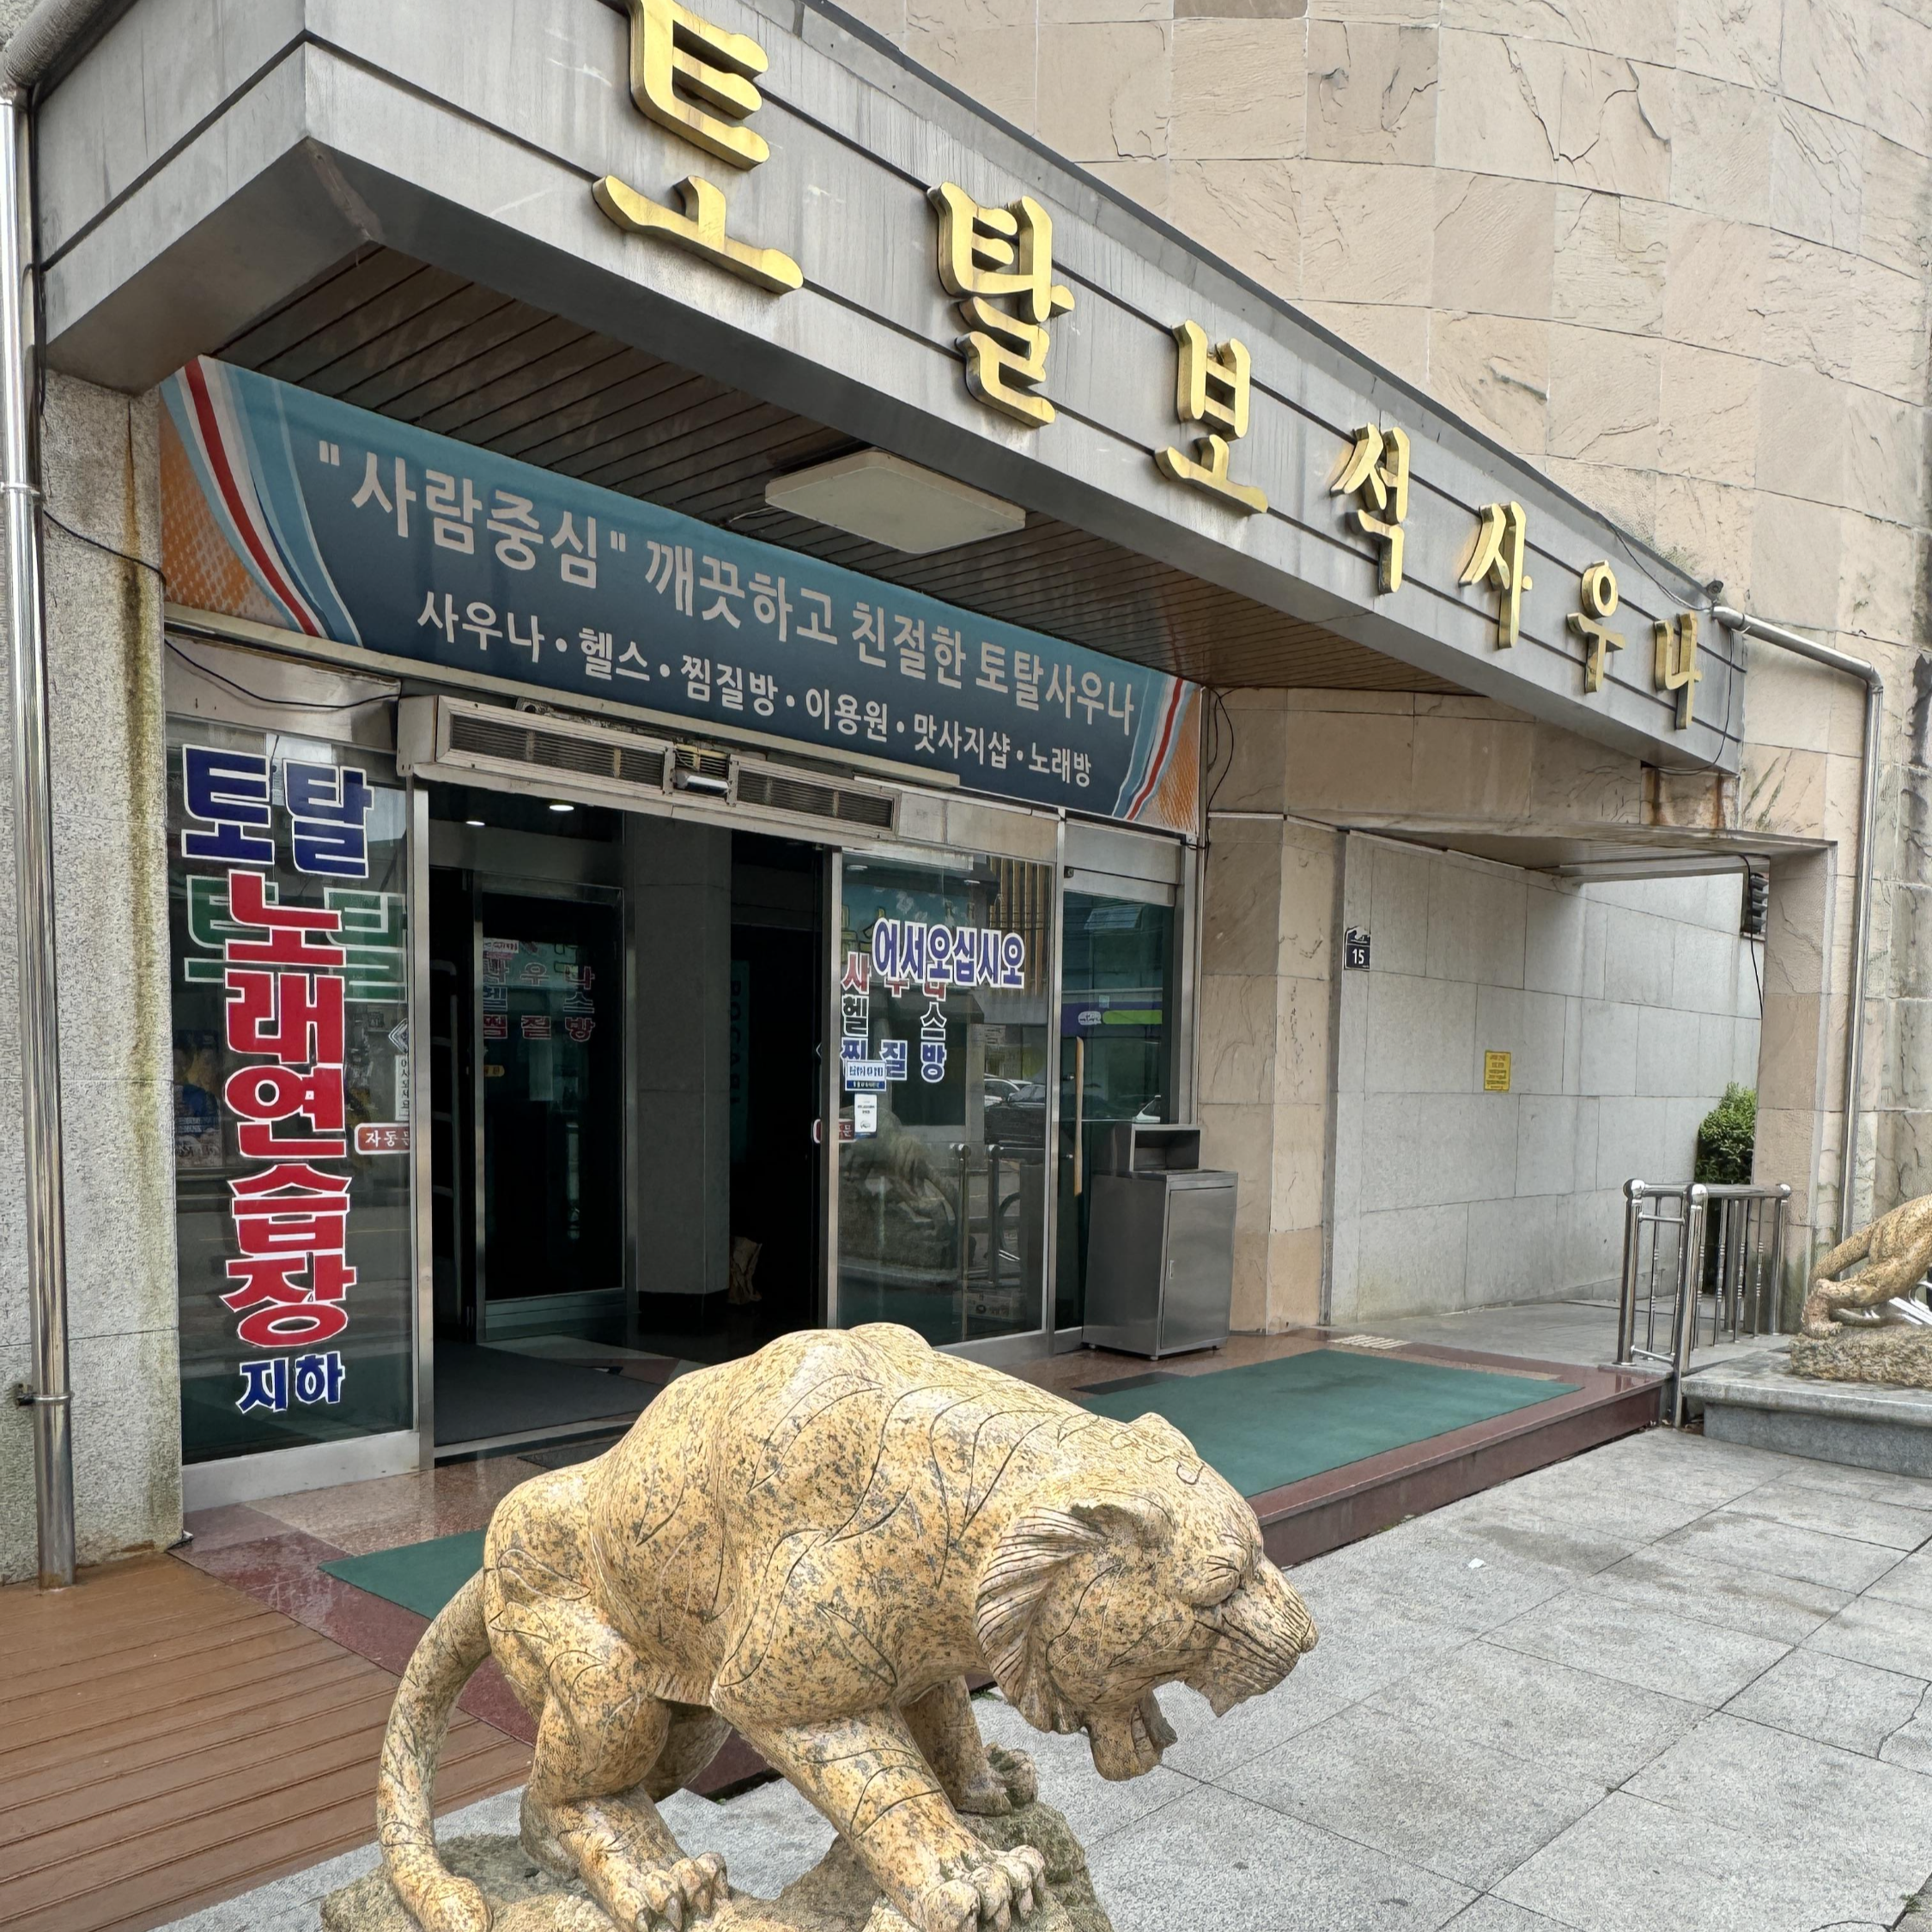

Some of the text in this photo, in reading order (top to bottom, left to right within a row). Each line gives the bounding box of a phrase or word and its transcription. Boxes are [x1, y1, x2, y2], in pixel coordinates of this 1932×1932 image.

[417, 591, 1091, 787] 사우나 헬스 찜질방 이용원 맛사지샵 노래방
[645, 541, 838, 646] 깨끗하고
[852, 601, 967, 690] 친절한
[975, 641, 1134, 736] 토탈사우나
[181, 744, 374, 878] 토탈
[872, 917, 1025, 989] 어서오십시오
[1352, 948, 1365, 964] 15
[219, 869, 359, 1348] 노래연습장
[235, 1351, 345, 1413] 지하
